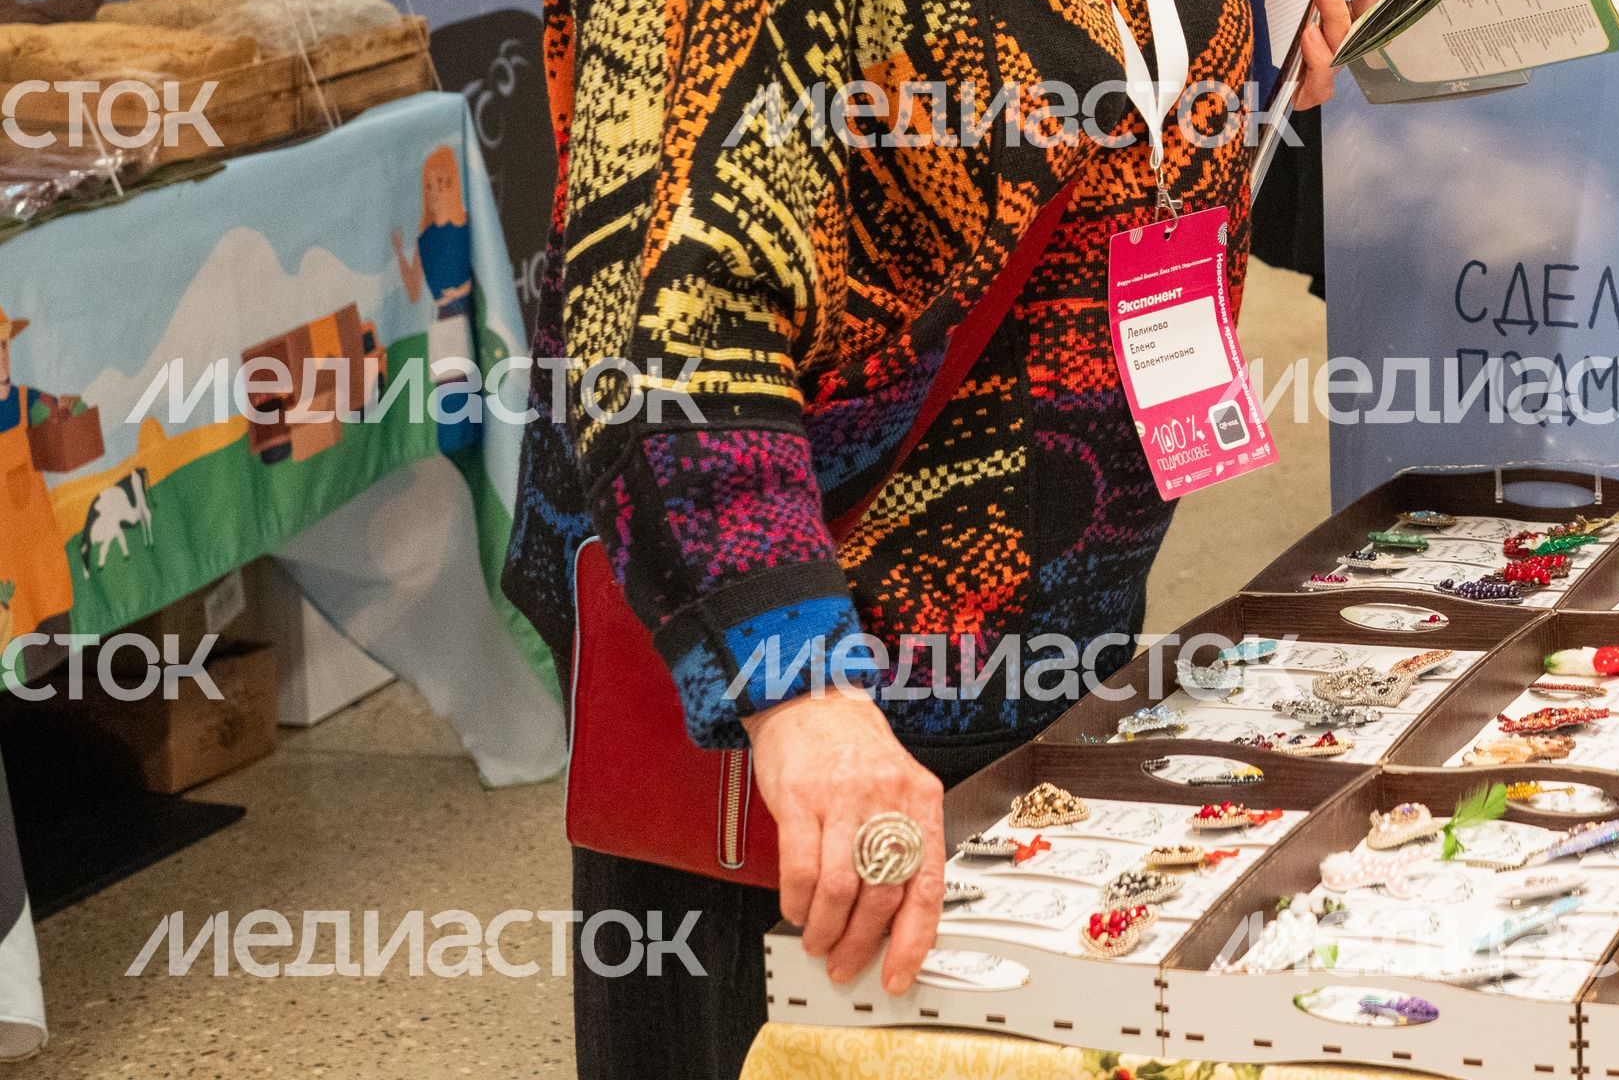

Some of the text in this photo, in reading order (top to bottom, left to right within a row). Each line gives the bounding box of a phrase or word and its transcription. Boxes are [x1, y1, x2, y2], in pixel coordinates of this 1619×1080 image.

[1117, 286, 1184, 315] Экспонент
[1216, 252, 1229, 324] Новогодняя
[1127, 321, 1169, 339] Леликова
[1130, 341, 1157, 355] Елена
[1134, 347, 1195, 371] Валентиновна
[1157, 443, 1211, 472] ПОДМОСКОВЬЕ
